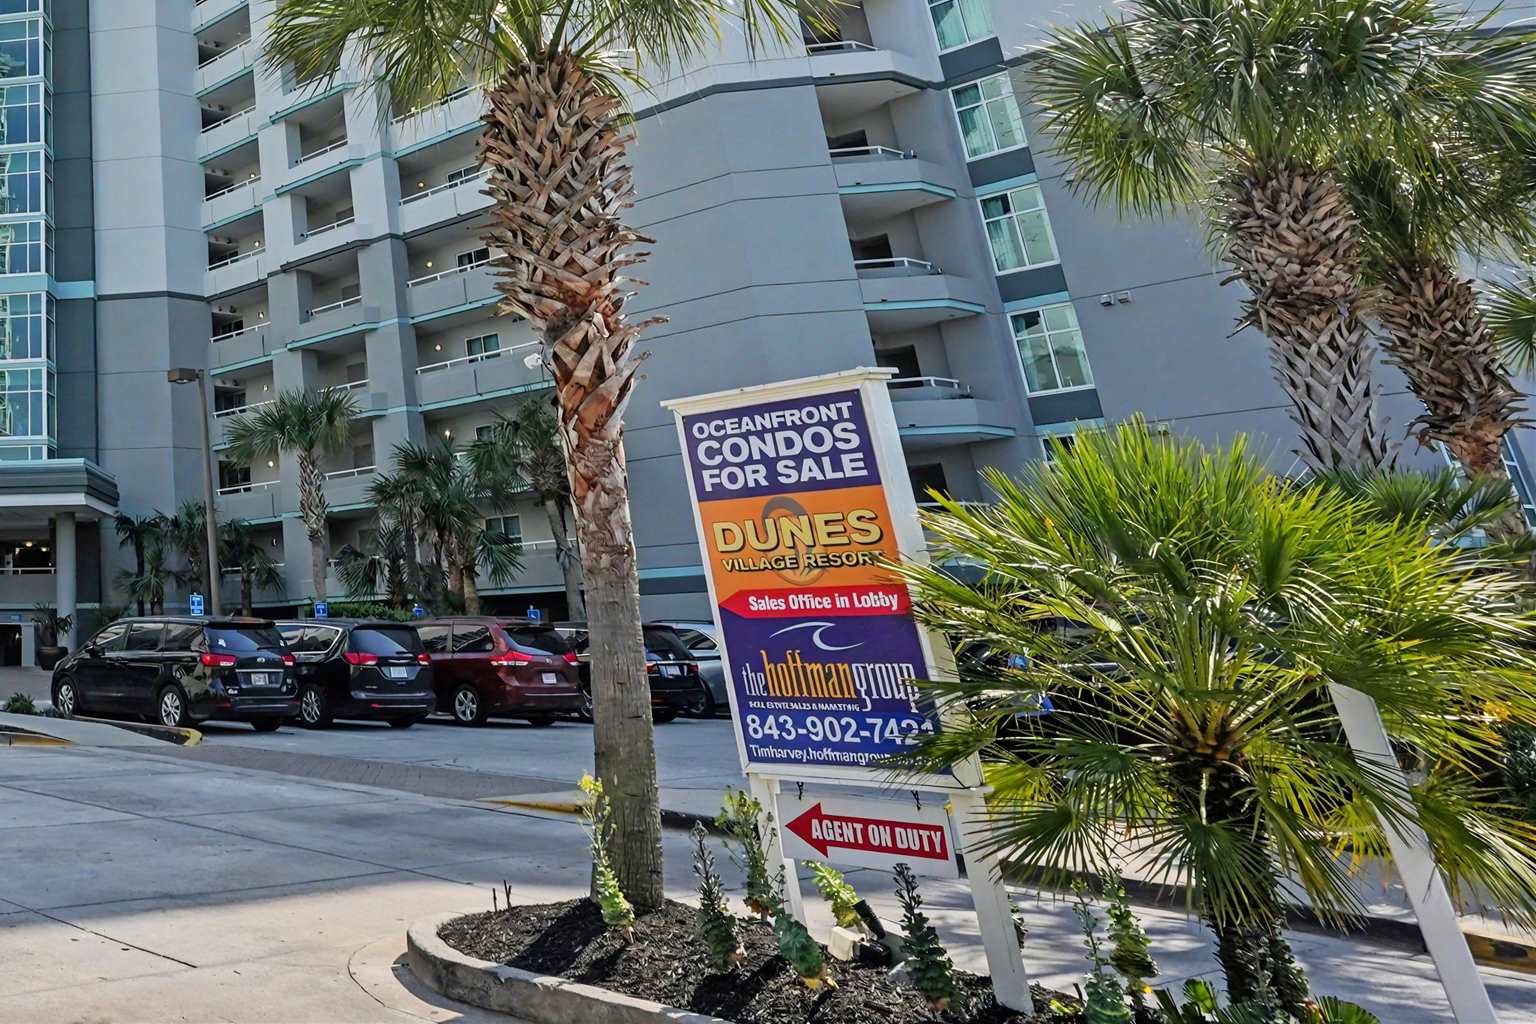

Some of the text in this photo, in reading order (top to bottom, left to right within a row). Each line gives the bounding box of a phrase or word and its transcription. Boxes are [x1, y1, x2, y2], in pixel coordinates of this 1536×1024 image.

[692, 401, 853, 439] OCEANFRONT
[696, 422, 861, 466] CONDOS
[701, 452, 868, 492] FOR SALE
[712, 509, 883, 553] DUNES
[722, 555, 799, 572] VILLAGE
[748, 592, 898, 611] Sales Office in Lobby
[811, 818, 942, 854] AGENT ON DUTY
